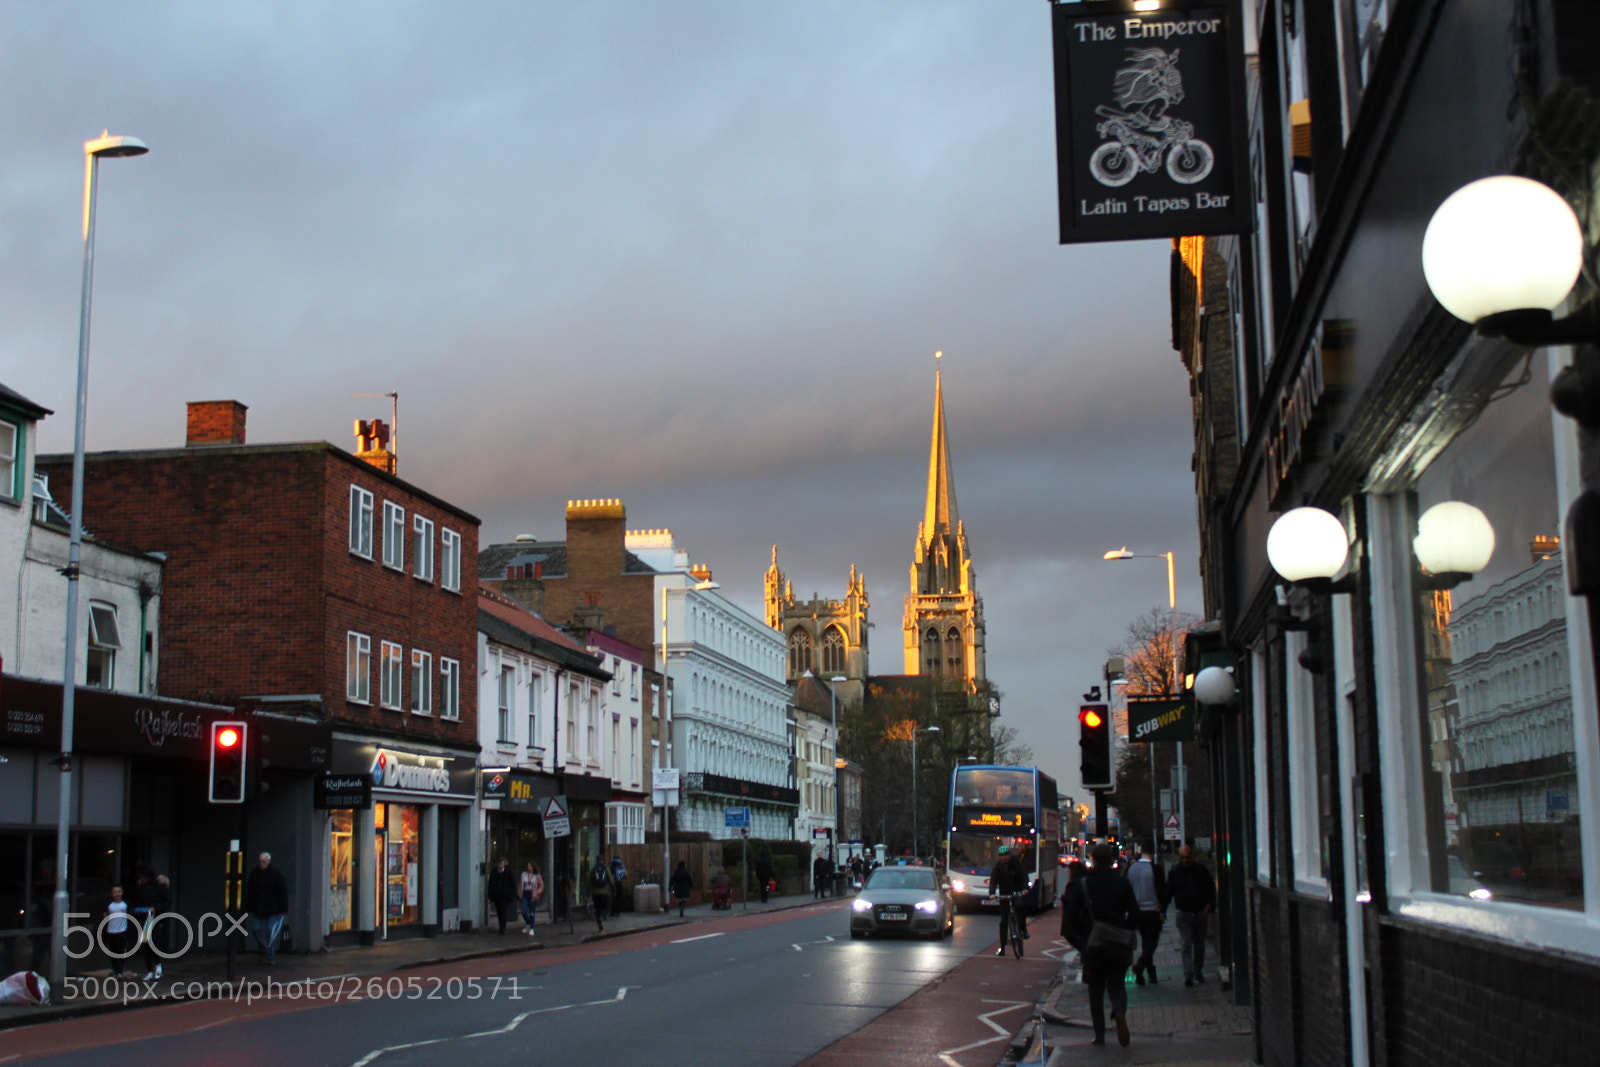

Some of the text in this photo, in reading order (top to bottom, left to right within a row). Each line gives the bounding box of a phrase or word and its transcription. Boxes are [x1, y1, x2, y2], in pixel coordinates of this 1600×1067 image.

[1073, 18, 1221, 42] The Emperor
[1081, 192, 1230, 216] Latin Tapas Bar
[1135, 705, 1186, 738] SUBWAY
[384, 754, 450, 792] Domino's
[1015, 814, 1022, 826] 3
